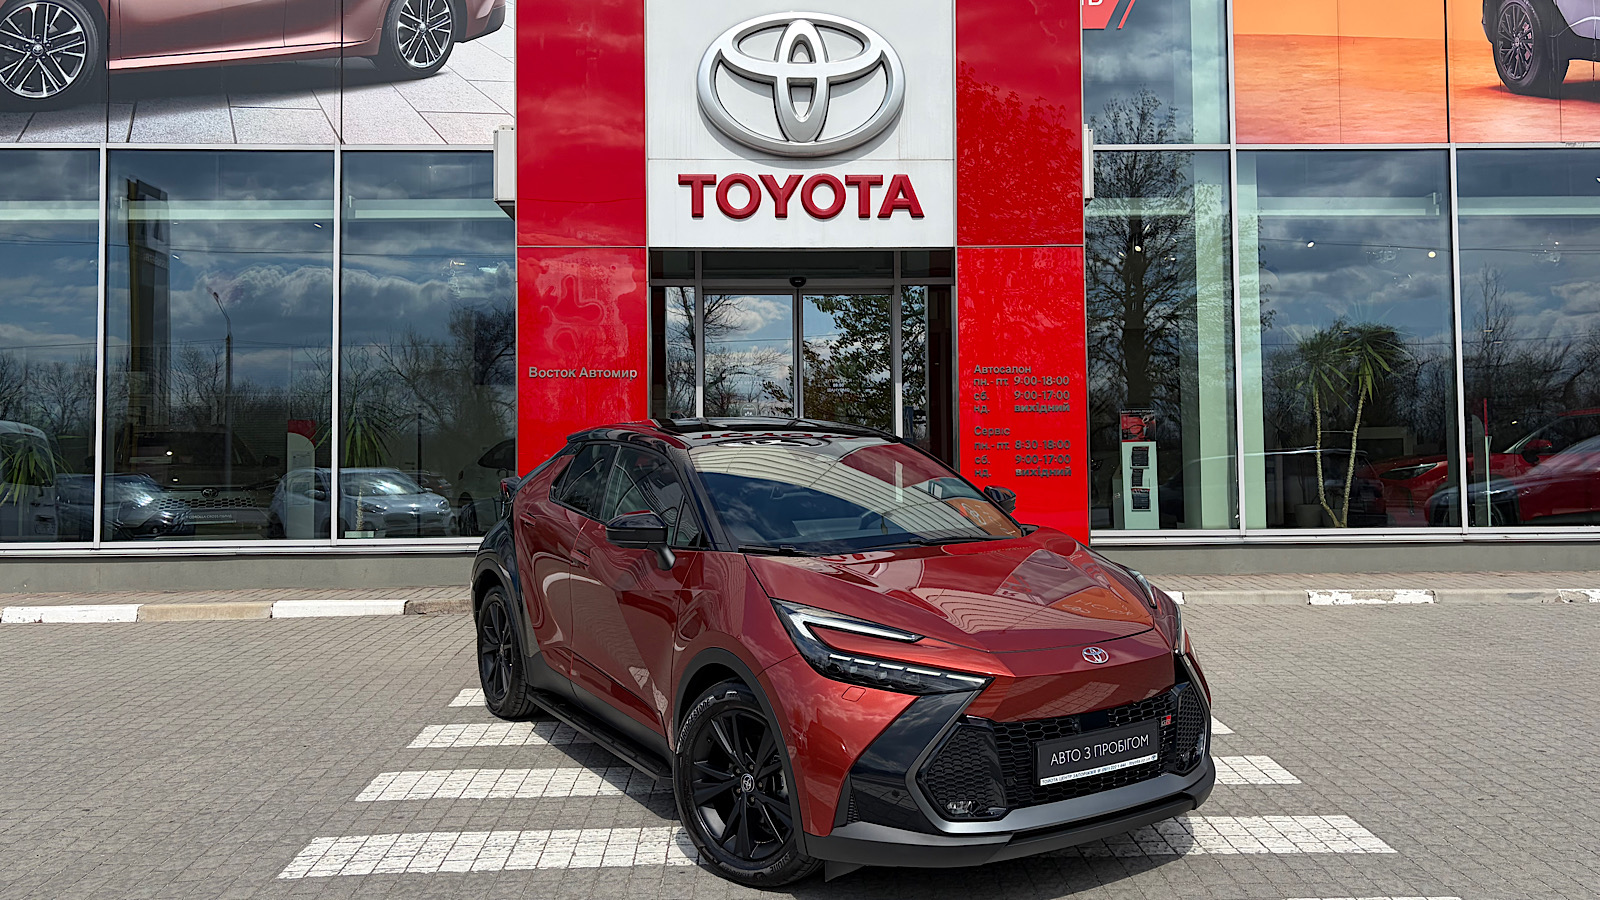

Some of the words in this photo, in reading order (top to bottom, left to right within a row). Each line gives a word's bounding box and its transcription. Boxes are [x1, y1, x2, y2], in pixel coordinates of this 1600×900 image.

[678, 173, 925, 219] TOYOTA
[528, 366, 577, 378] Восток
[579, 367, 638, 381] Автомир
[974, 365, 1032, 374] Автосалон
[1014, 376, 1070, 386] 9:00-18:00
[974, 391, 989, 400] сб.
[1014, 390, 1070, 400] 9:00-17:00
[974, 405, 990, 413] нд.
[1014, 402, 1070, 413] вихідний
[974, 426, 1010, 437] Сервіс
[1015, 440, 1071, 449] 8:30-18:00
[974, 455, 990, 464] сб.
[1015, 454, 1071, 464] 9:00-17:00
[974, 469, 991, 478] нд.
[1015, 466, 1072, 478] вихідний
[1050, 749, 1081, 766] АВТО
[1094, 734, 1149, 757] ПРОБІГОМ
